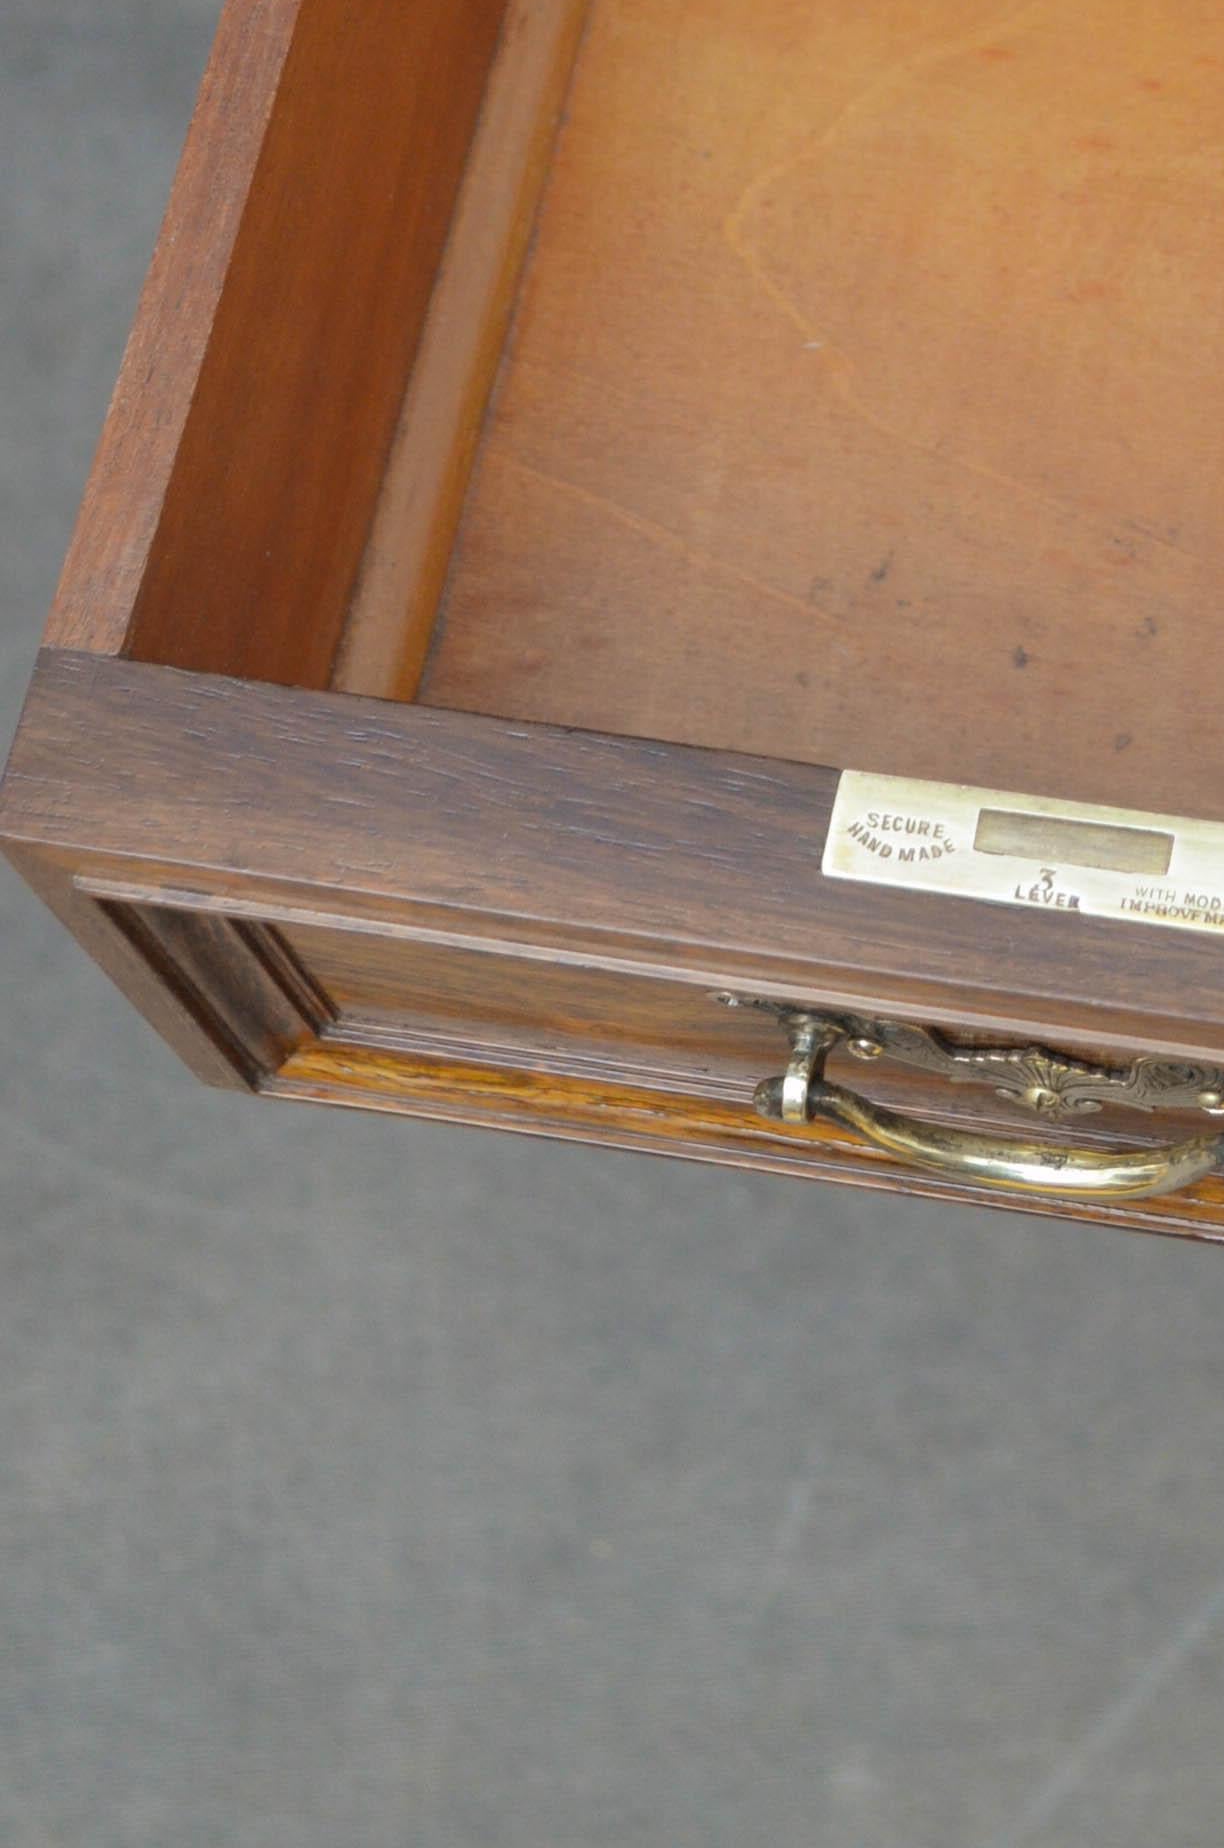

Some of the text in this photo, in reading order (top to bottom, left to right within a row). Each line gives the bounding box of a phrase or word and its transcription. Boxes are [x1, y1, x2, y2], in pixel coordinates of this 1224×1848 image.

[867, 812, 945, 838] SECURE
[847, 821, 956, 863] HAND MADE
[1038, 867, 1057, 892] 3
[1014, 884, 1080, 908] LEVER
[1135, 886, 1177, 902] WITH
